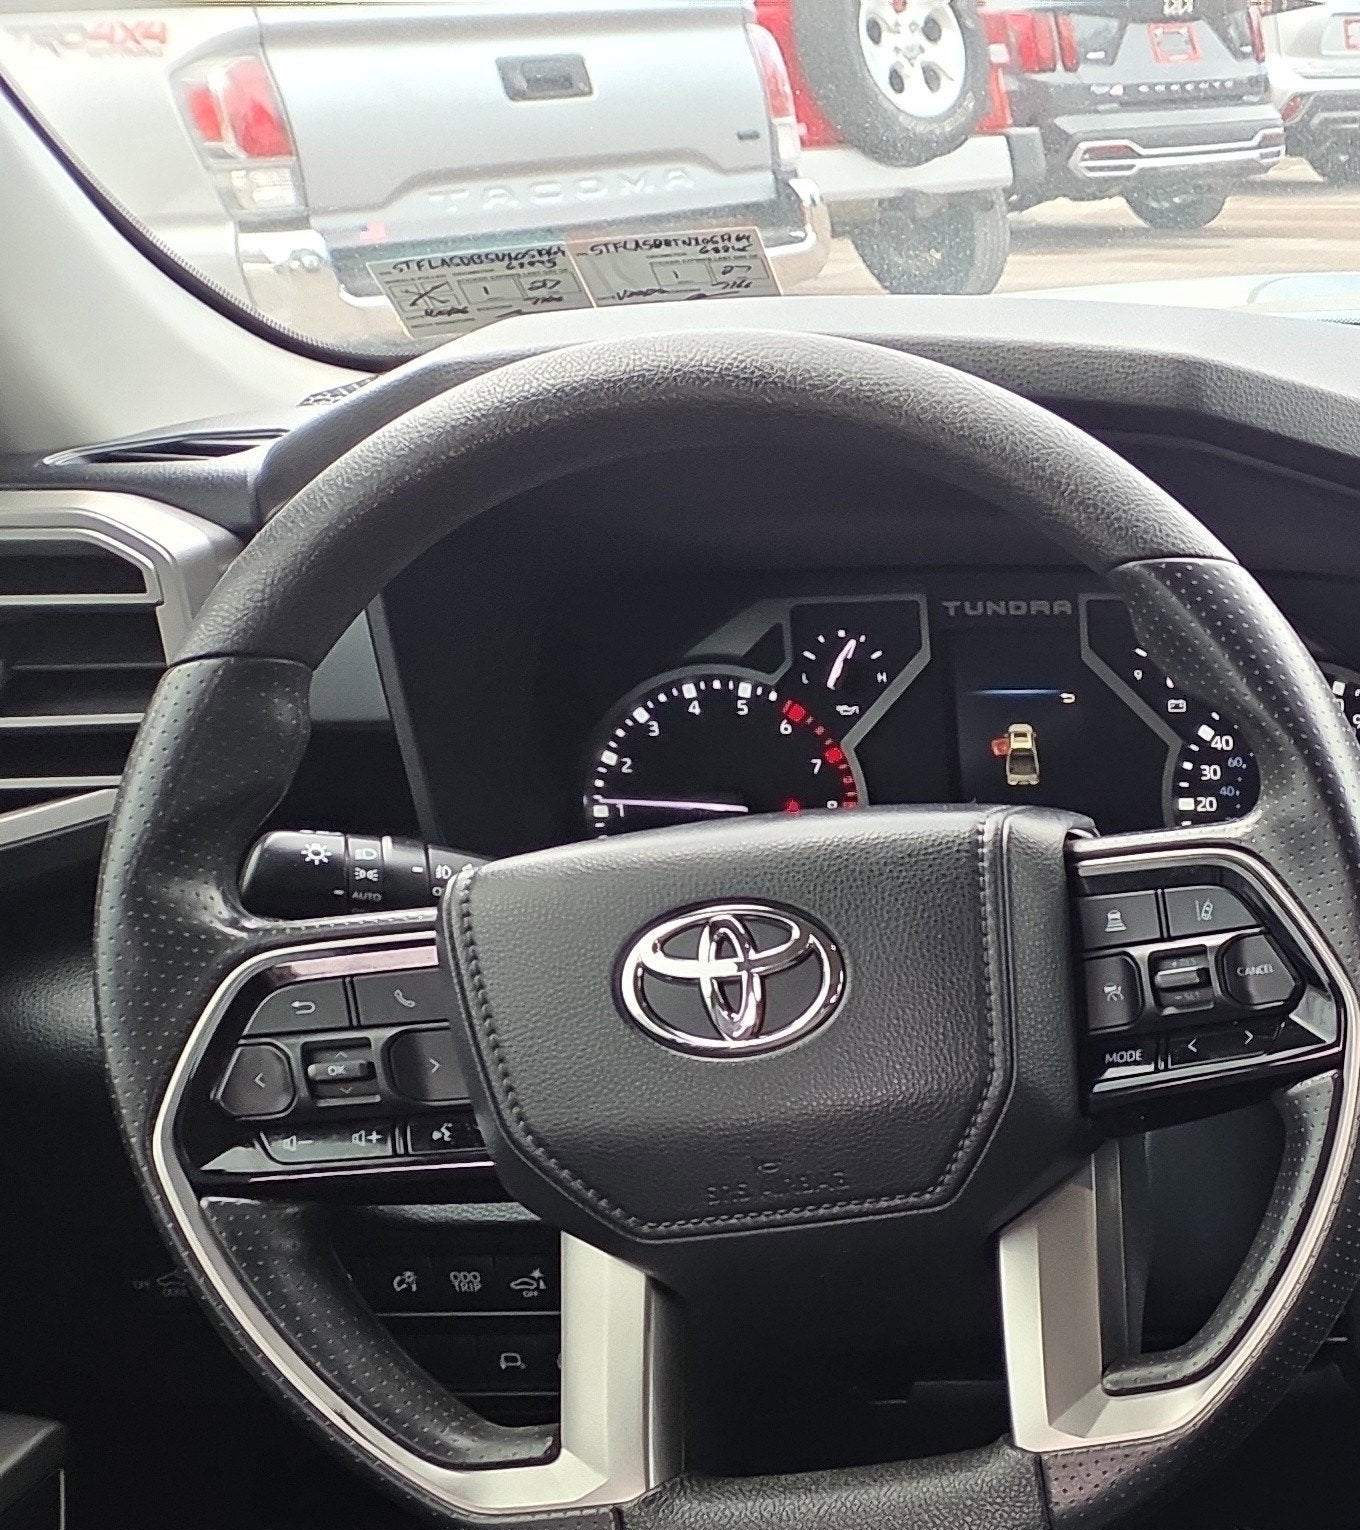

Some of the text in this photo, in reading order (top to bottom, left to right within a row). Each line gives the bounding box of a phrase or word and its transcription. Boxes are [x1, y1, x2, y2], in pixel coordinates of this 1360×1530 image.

[428, 166, 695, 213] TACOMA
[942, 600, 1072, 616] TUNDRA
[687, 700, 701, 715] 4
[736, 700, 749, 715] 5
[648, 721, 660, 737] 3
[779, 719, 793, 735] 6
[1210, 735, 1234, 751] 40
[621, 758, 633, 773] 2
[811, 758, 822, 774] 7
[1200, 764, 1222, 781] 30
[1196, 796, 1218, 812] 20
[352, 891, 382, 902] AUTO
[1236, 964, 1274, 977] CANCEL
[1105, 1049, 1142, 1064] MODE
[327, 1064, 346, 1075] OK
